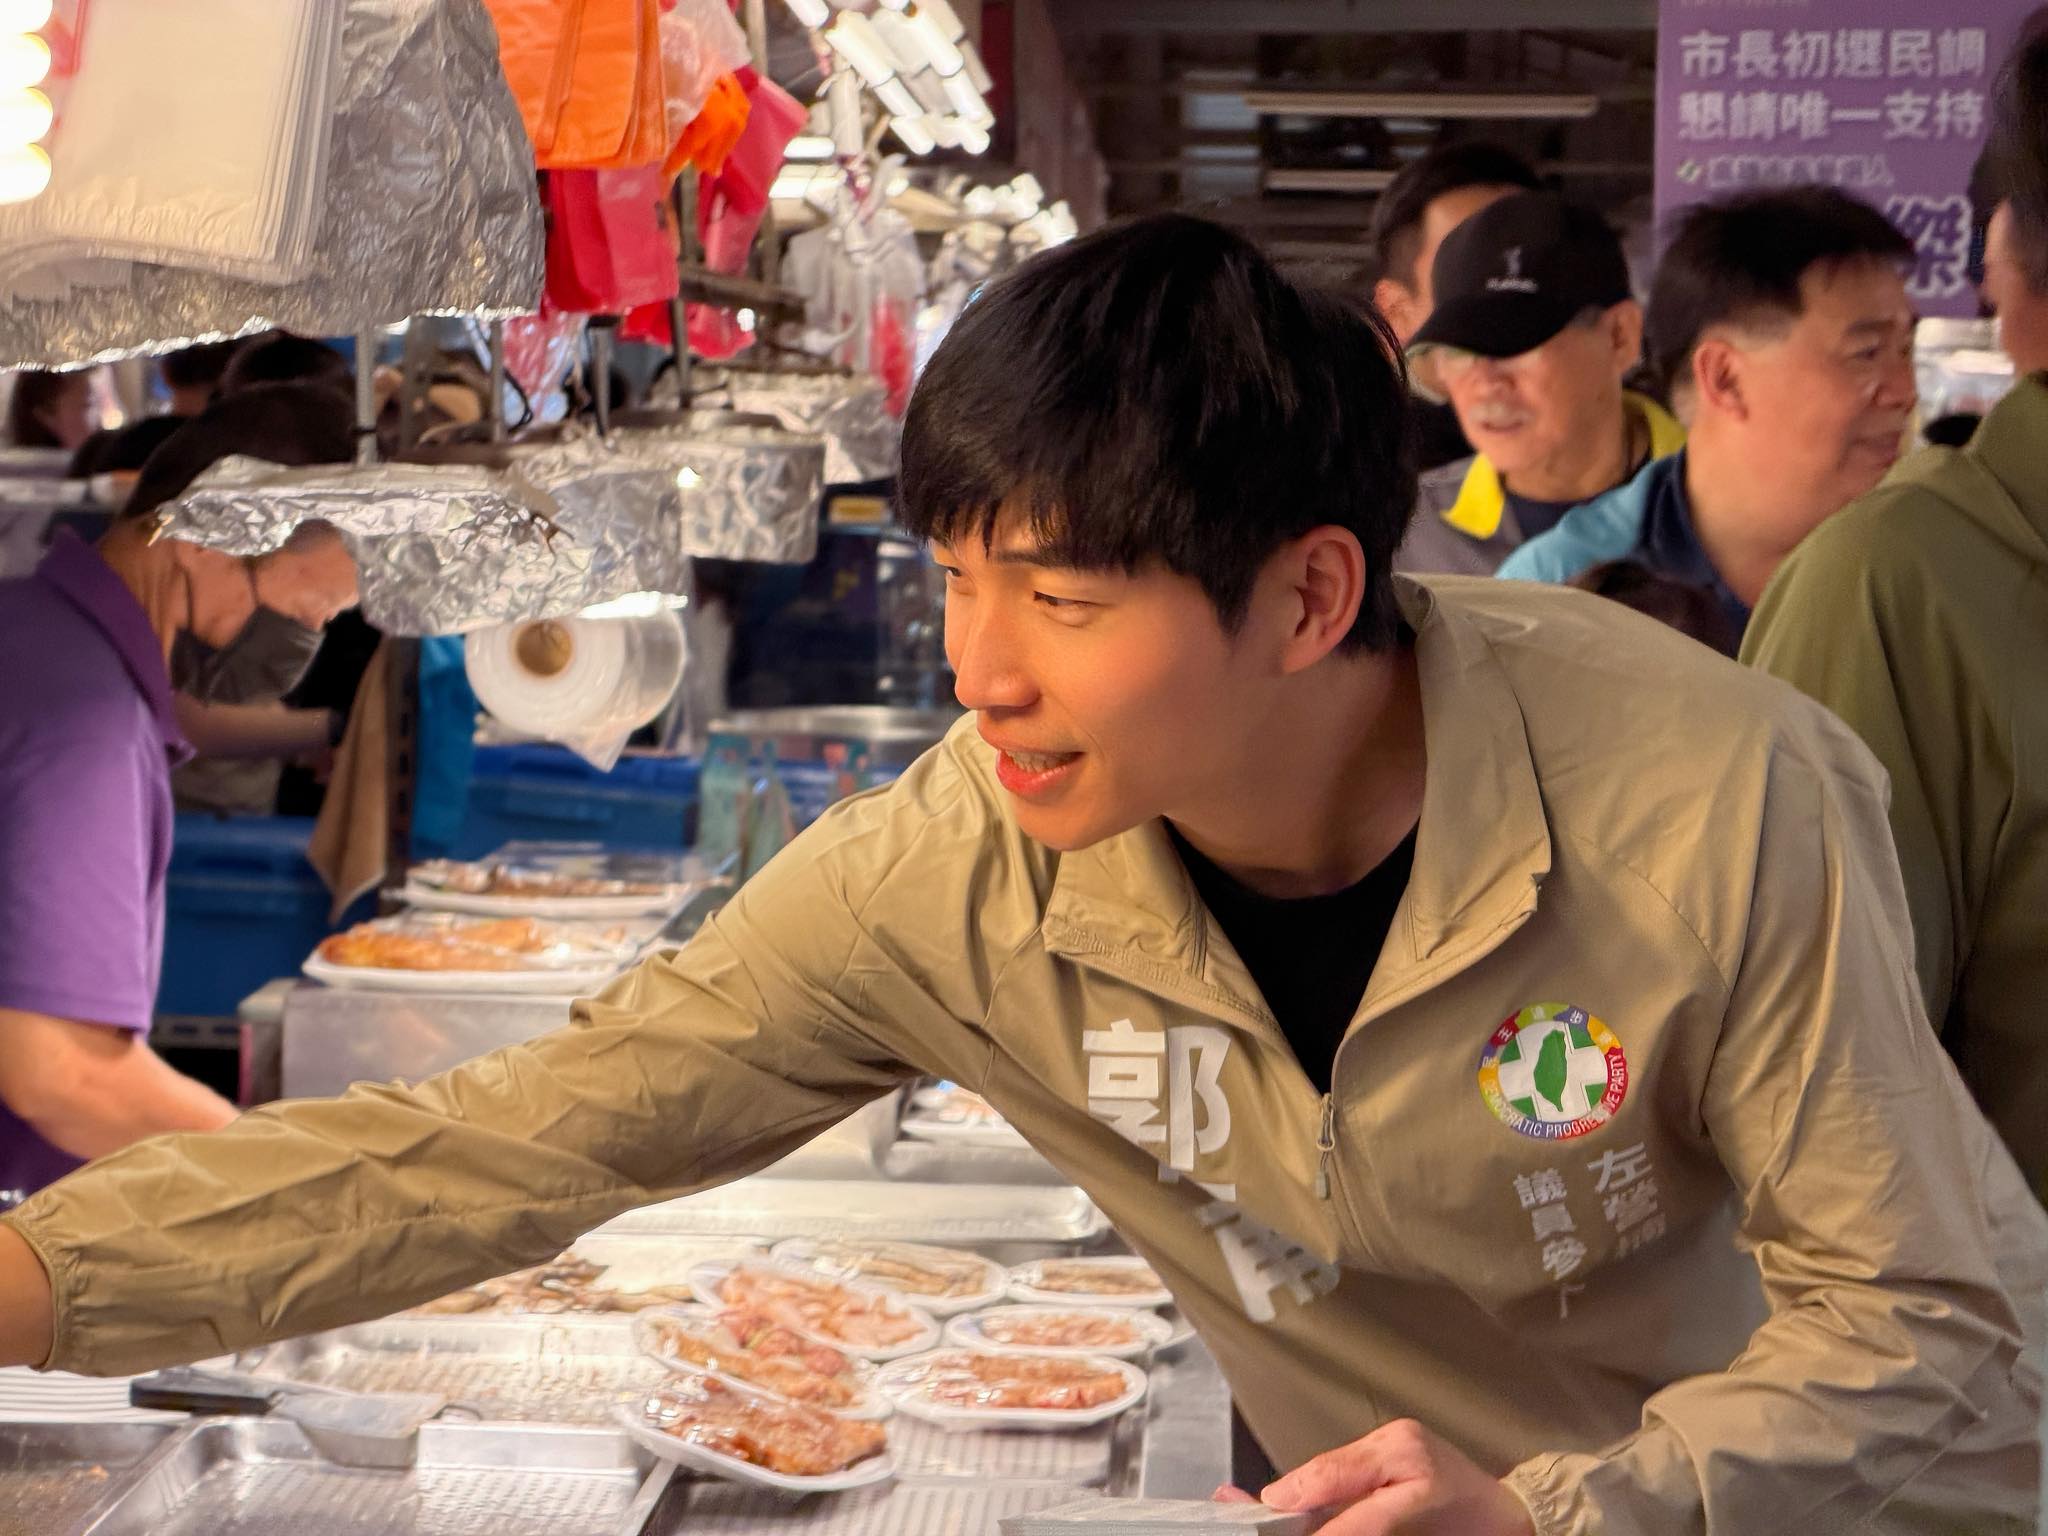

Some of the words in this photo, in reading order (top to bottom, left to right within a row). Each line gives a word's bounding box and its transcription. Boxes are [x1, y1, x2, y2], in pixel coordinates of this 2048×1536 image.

[1679, 28, 1987, 79] 市長初選民調
[1608, 1053, 1624, 1094] PARTY
